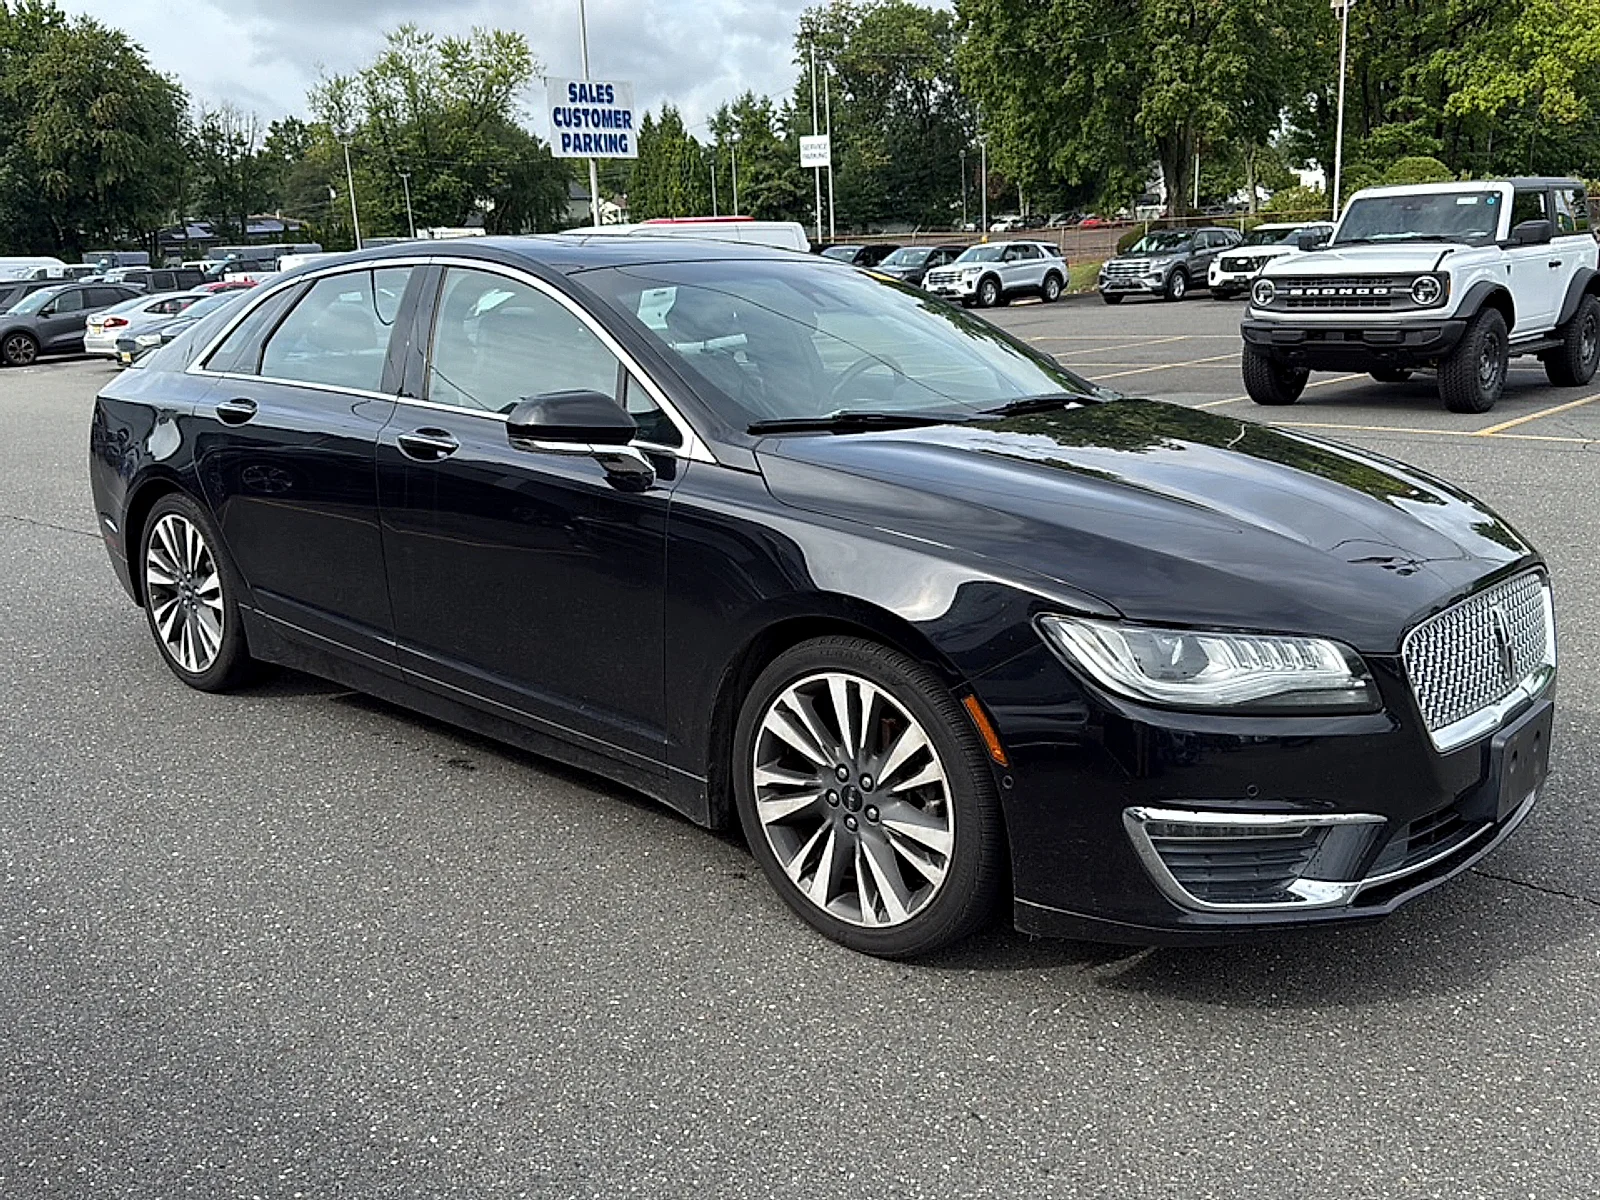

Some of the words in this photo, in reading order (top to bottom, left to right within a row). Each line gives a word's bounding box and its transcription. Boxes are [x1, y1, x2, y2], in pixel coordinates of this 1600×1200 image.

[568, 82, 615, 104] SALES
[553, 107, 633, 129] CUSTOMER
[561, 133, 628, 153] PARKING
[802, 143, 828, 151] SERVICE
